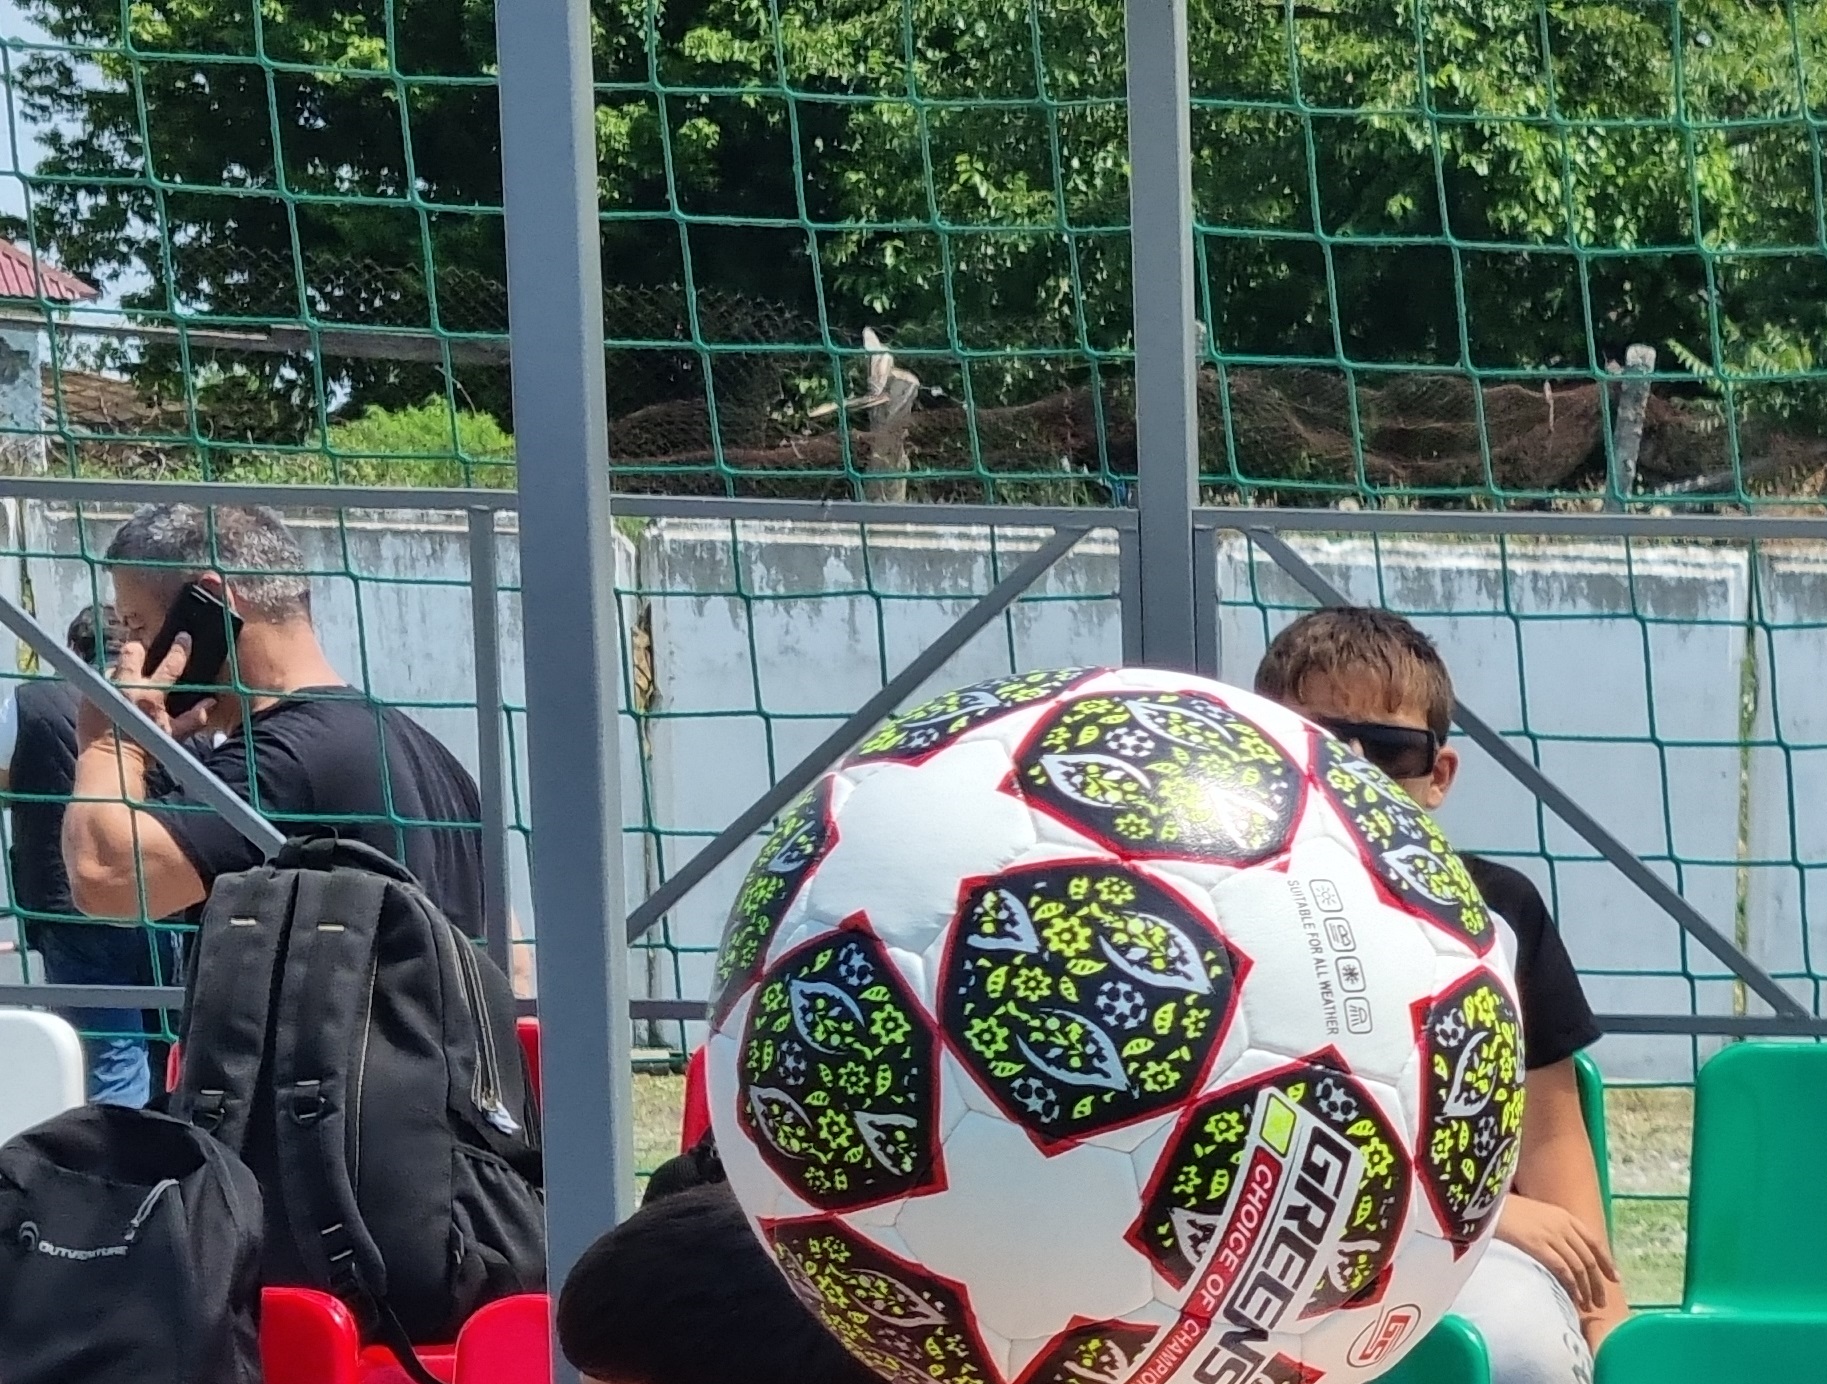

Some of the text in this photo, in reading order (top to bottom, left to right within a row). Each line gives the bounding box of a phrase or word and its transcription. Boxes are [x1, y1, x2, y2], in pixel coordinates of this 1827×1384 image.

[1287, 879, 1340, 1036] SUITABLE FOR ALL WEATHER
[1218, 1163, 1273, 1266] CHOICE
[1200, 1272, 1226, 1312] OF
